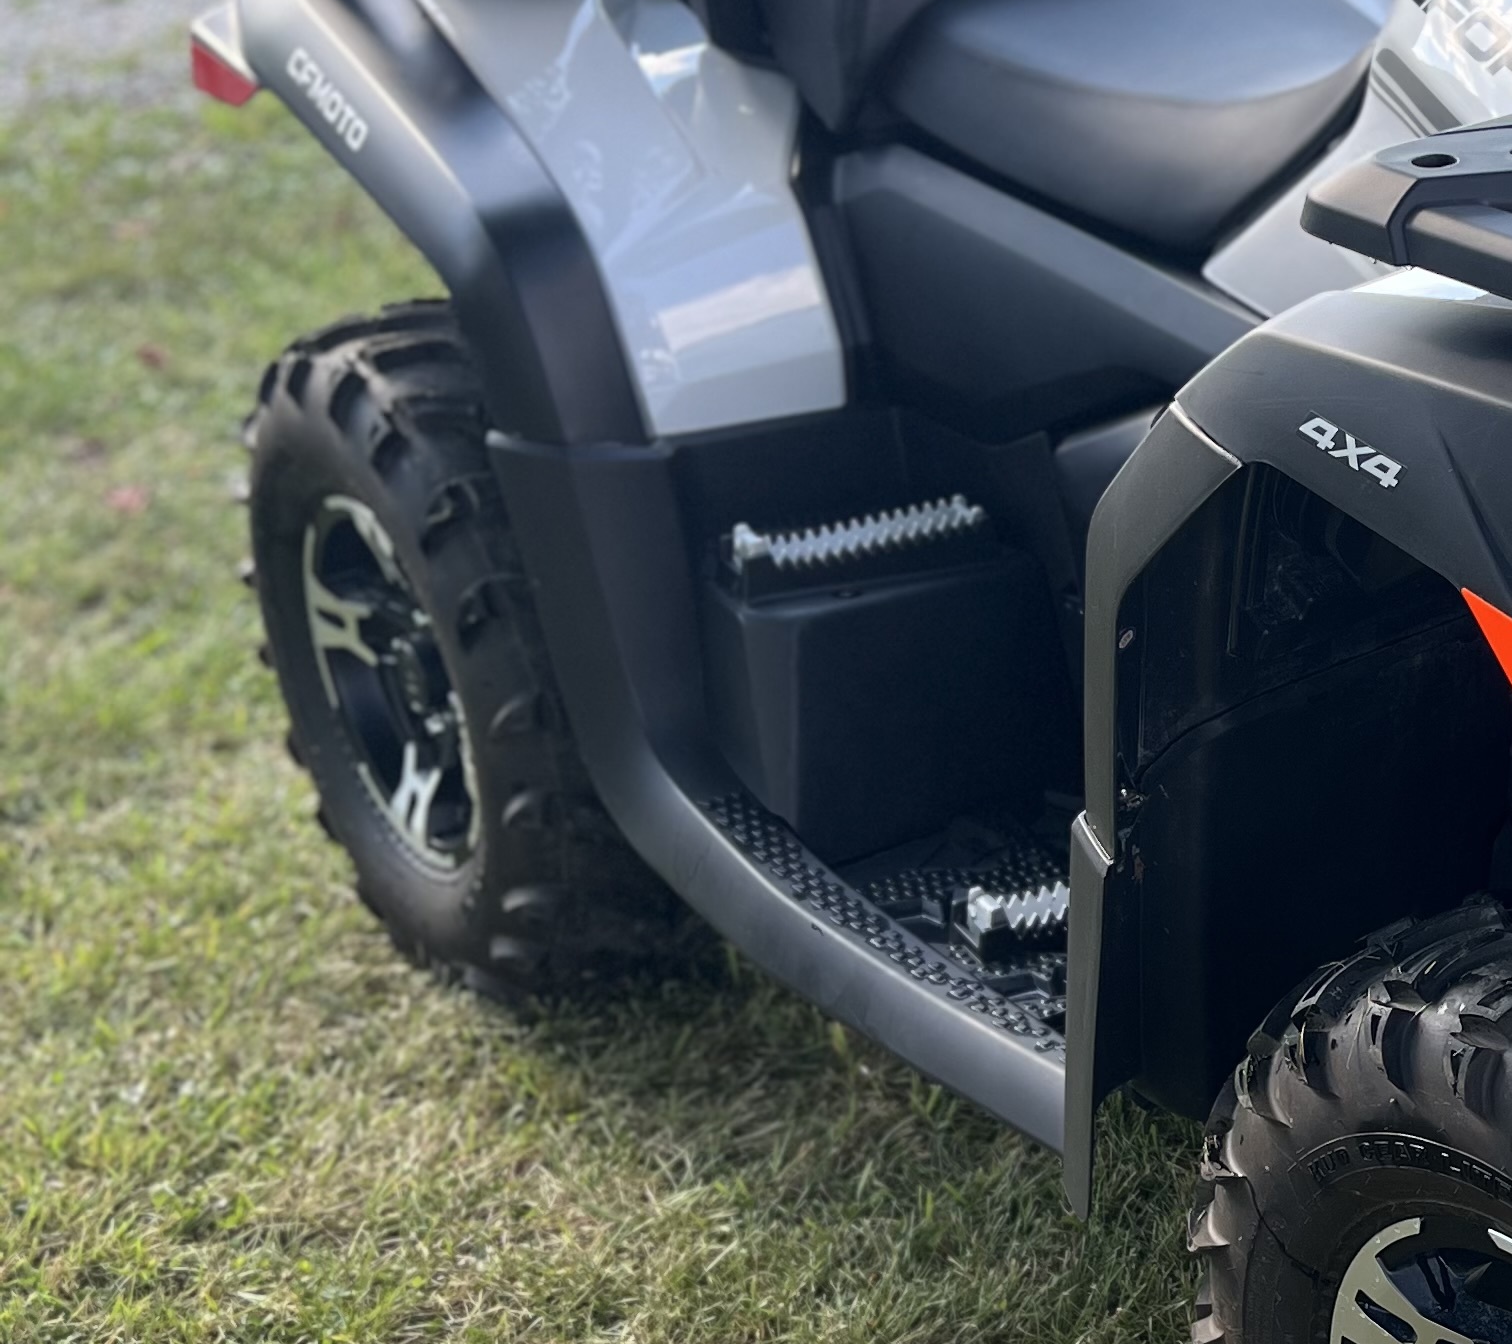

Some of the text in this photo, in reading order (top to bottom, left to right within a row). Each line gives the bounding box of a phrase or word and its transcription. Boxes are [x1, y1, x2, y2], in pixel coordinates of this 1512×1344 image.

[286, 47, 369, 151] CFMOTO
[1299, 417, 1402, 488] 4X4
[1307, 1145, 1350, 1183] MUD
[1358, 1140, 1430, 1164] GEAR
